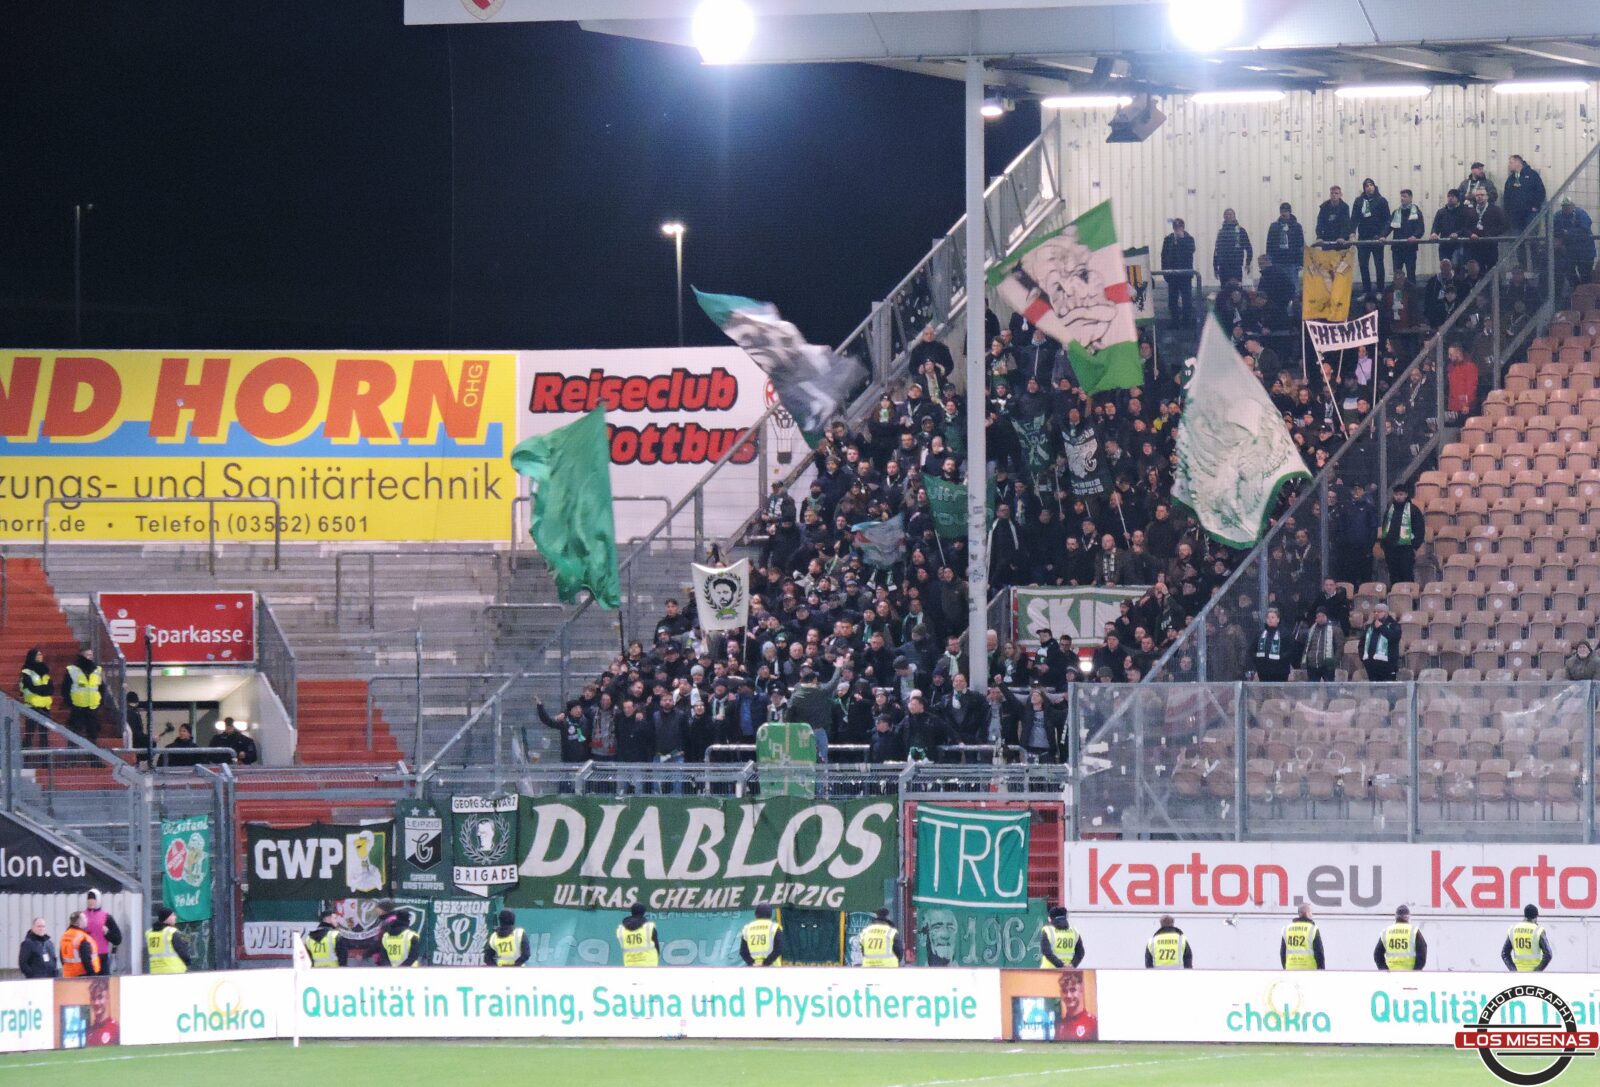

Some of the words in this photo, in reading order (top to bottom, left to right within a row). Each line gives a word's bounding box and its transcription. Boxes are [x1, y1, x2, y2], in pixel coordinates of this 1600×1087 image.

[1310, 315, 1377, 345] CHEMIE!
[463, 364, 483, 407] OHG
[529, 367, 738, 413] Reiseclub
[148, 357, 490, 440] HORN
[607, 423, 759, 465] ottbus
[135, 461, 205, 499] und
[223, 462, 502, 500] Sanitärtechnik
[136, 516, 219, 532] Telefon
[228, 514, 310, 535] (03562)
[318, 516, 368, 532] 6501
[148, 626, 243, 647] Sparkasse
[454, 799, 479, 809] GEORG
[407, 819, 440, 829] LEIPZIG
[519, 803, 893, 880] DIABLOS
[254, 838, 343, 880] GWP
[455, 867, 516, 881] BRIGADE
[1088, 848, 1382, 907] karton.eu
[1430, 850, 1597, 909] karto
[553, 884, 638, 908] ULTRAS
[650, 887, 744, 909] CHEMIE
[752, 883, 845, 908] LEIPZIG
[388, 944, 402, 955] 281
[626, 933, 643, 945] 476
[750, 935, 766, 946] 279
[867, 938, 883, 949] 277
[1056, 937, 1074, 949] 280
[1287, 936, 1305, 947] 462
[1389, 938, 1408, 950] 465
[1515, 938, 1532, 949] 105
[1158, 949, 1176, 961] 272
[303, 986, 415, 1017] Qualität
[423, 987, 447, 1017] in
[457, 987, 585, 1024] Training,
[593, 987, 682, 1018] Sauna
[693, 987, 746, 1018] und
[757, 987, 977, 1026] Physiotherapie
[1227, 1002, 1331, 1033] chakra
[177, 1003, 265, 1034] chakra
